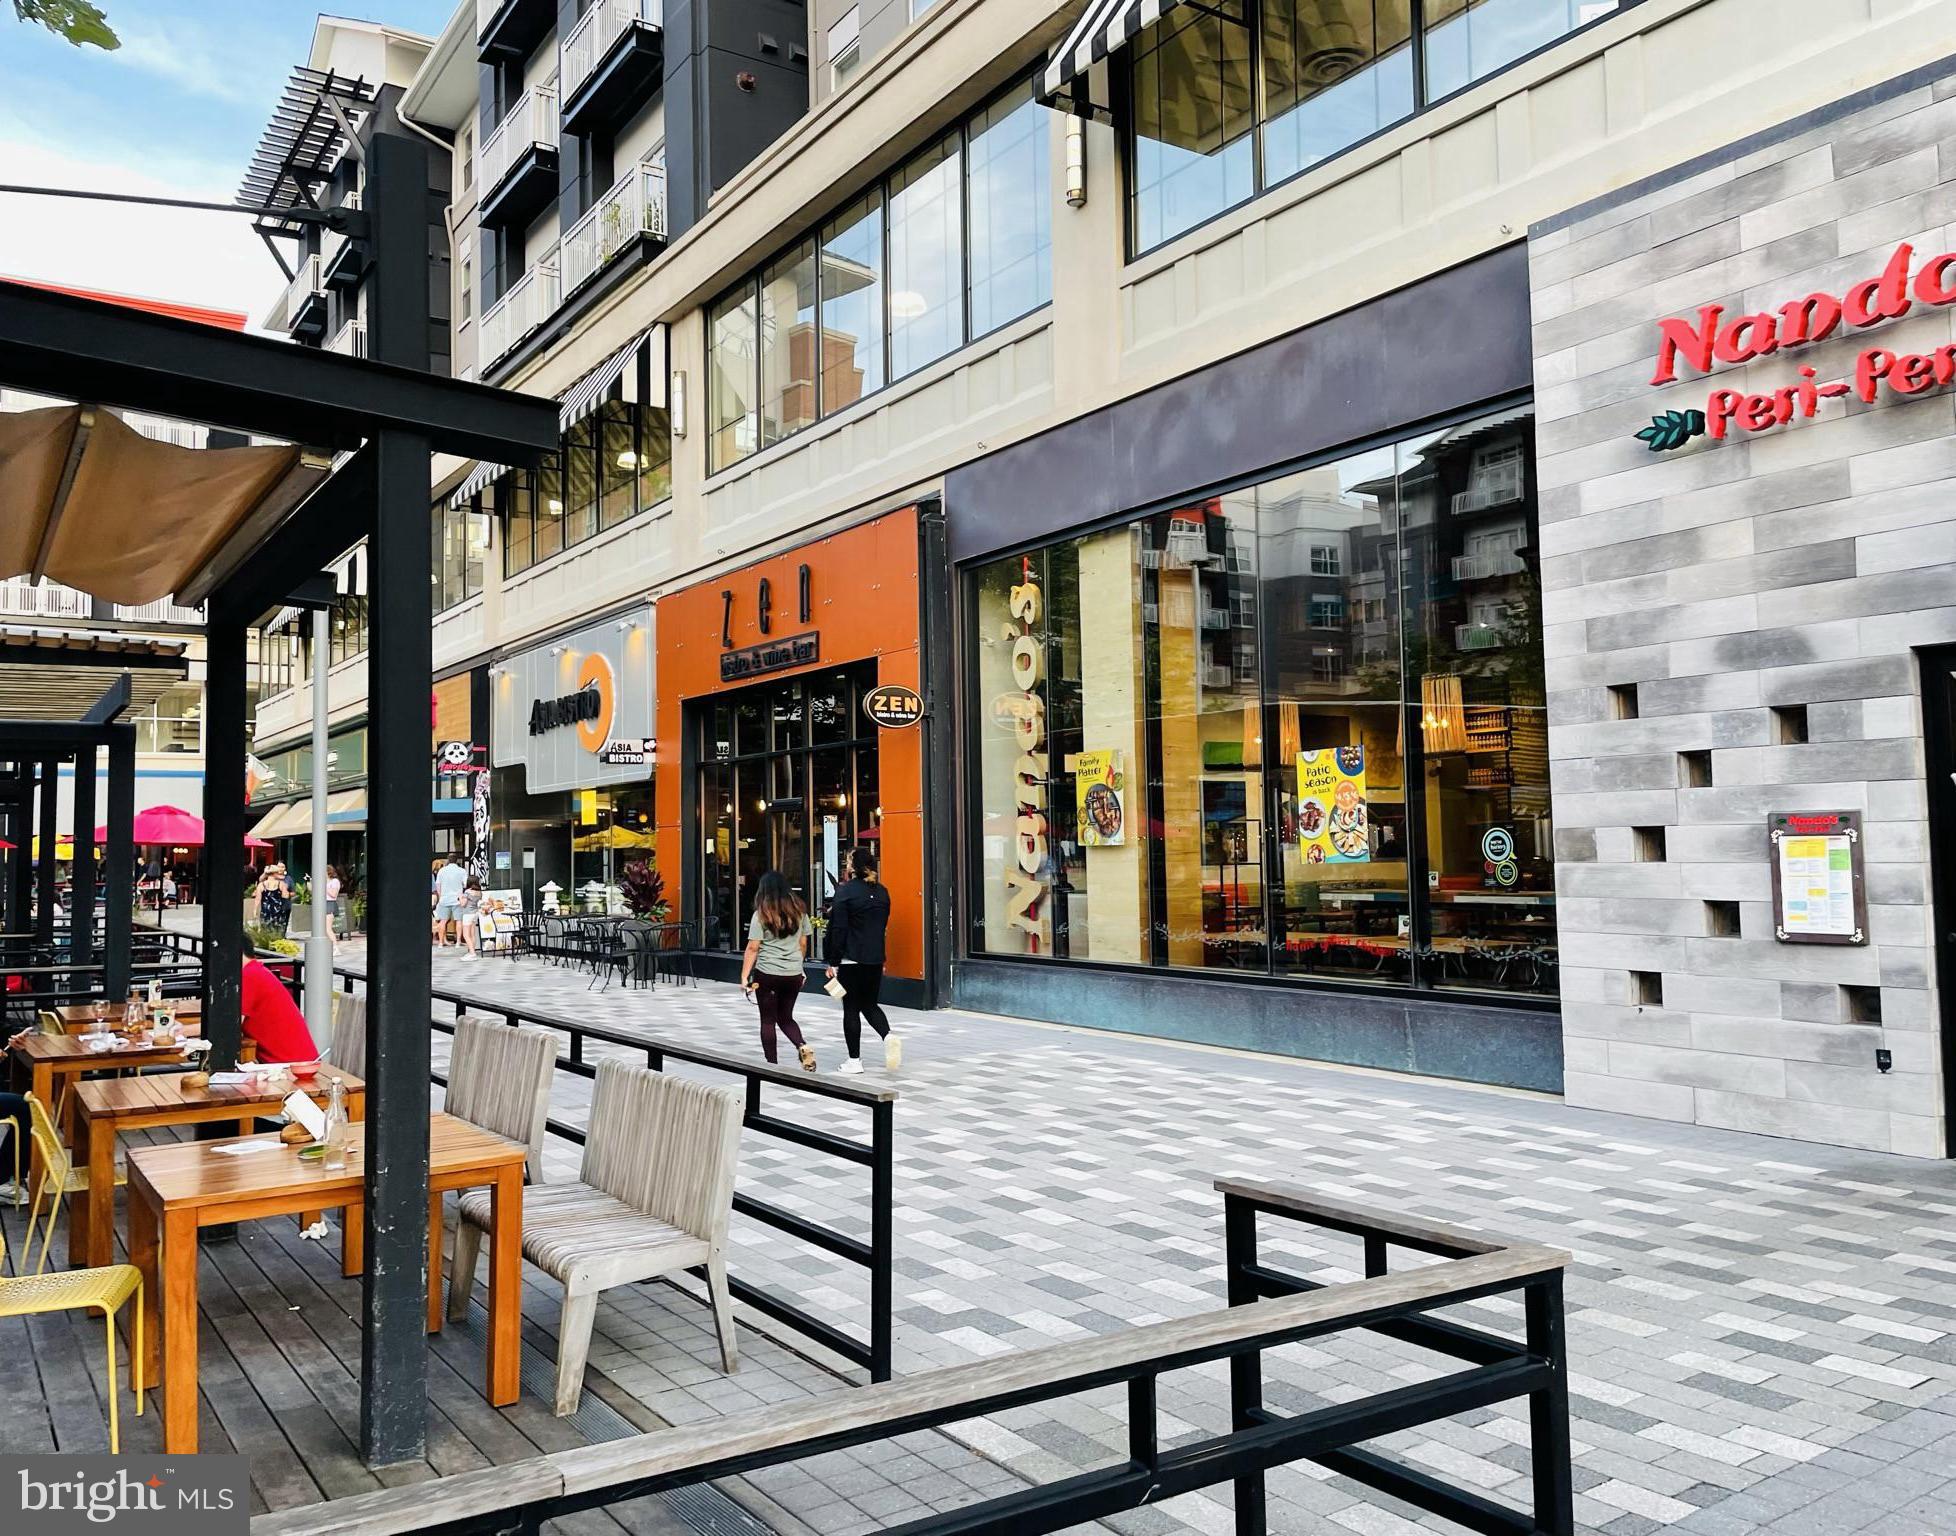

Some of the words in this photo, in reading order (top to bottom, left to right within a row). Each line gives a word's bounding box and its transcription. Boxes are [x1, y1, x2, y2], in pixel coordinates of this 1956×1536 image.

[1649, 242, 1956, 386] Nando
[874, 695, 918, 712] ZEN
[611, 742, 632, 753] ASIA
[609, 754, 643, 763] BISTRO
[1080, 757, 1100, 767] Family
[1078, 767, 1101, 777] Platter
[1306, 764, 1331, 777] Patio
[1305, 776, 1337, 789] season
